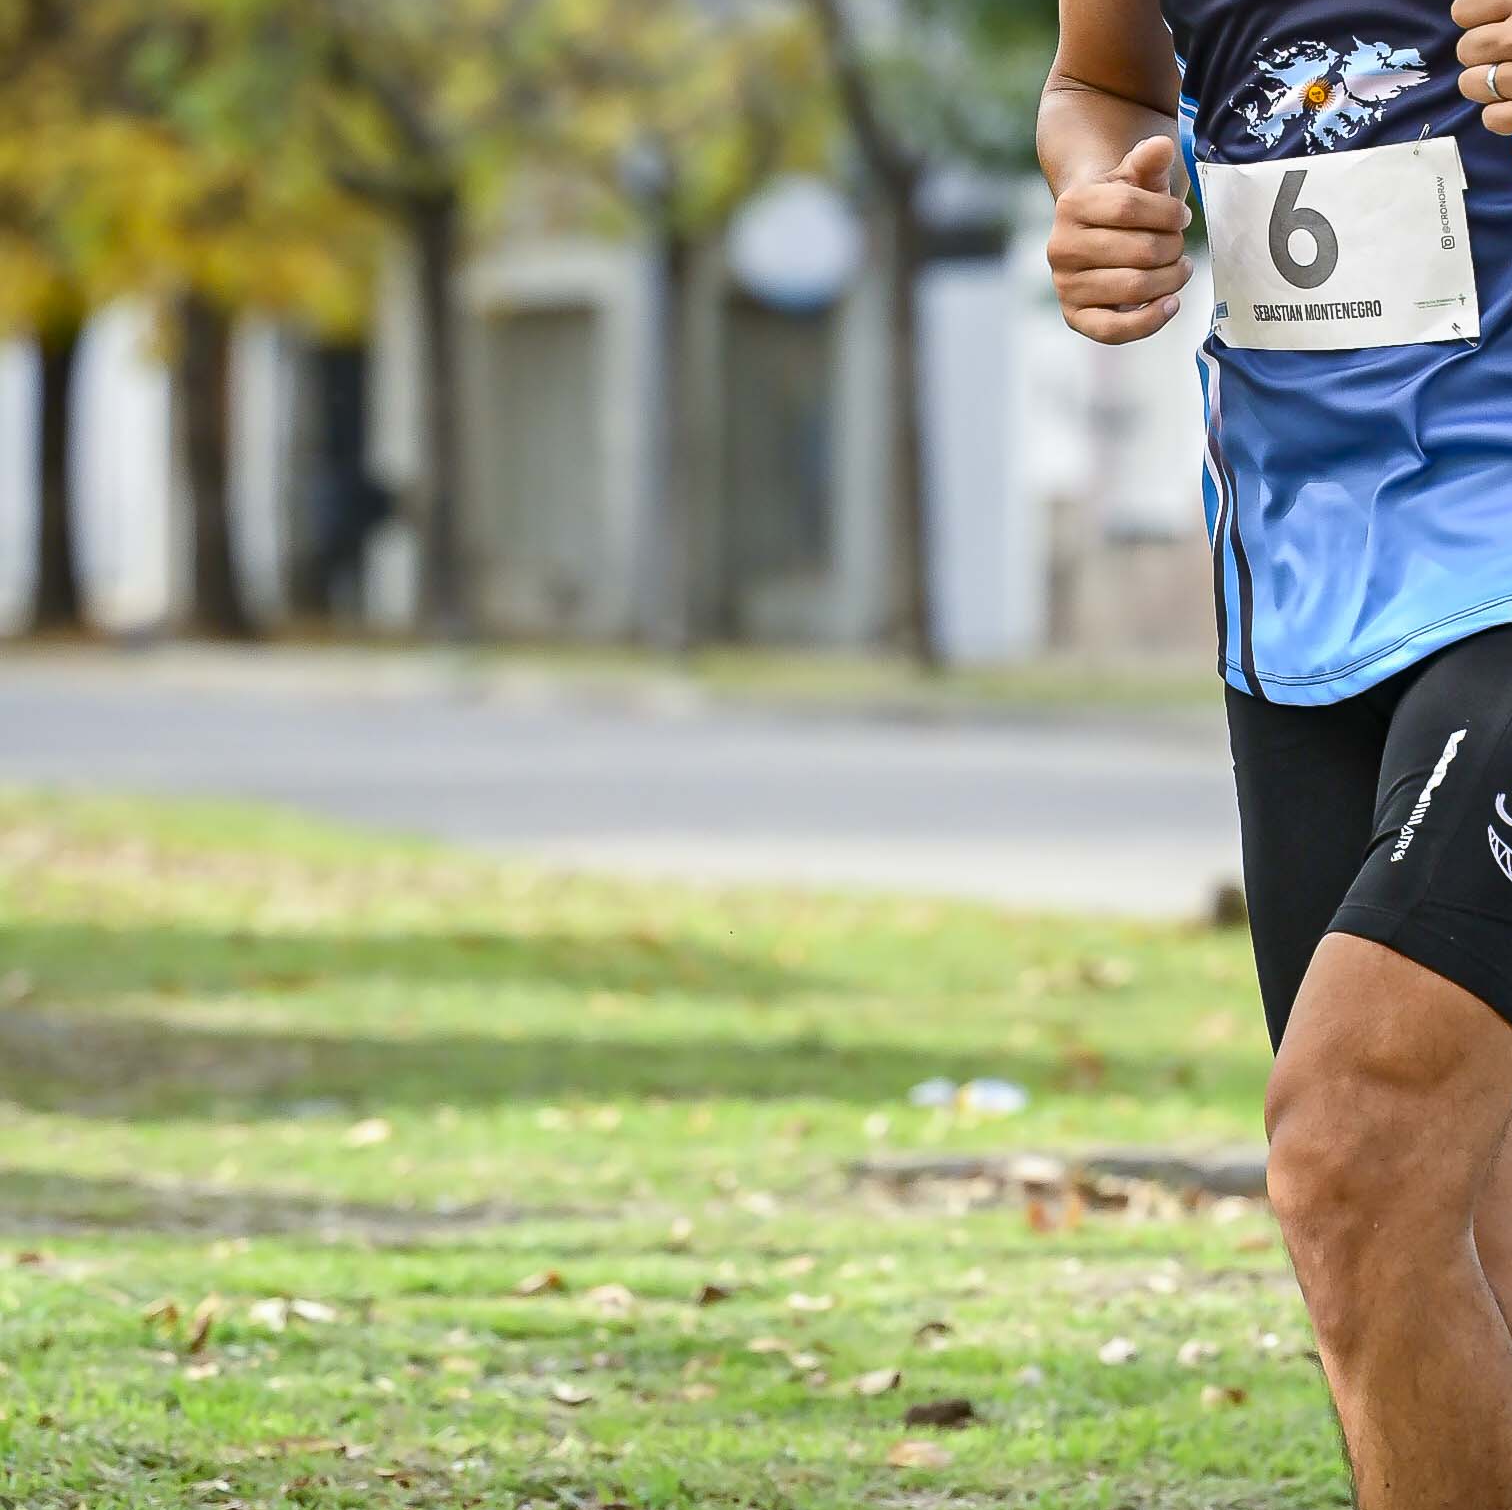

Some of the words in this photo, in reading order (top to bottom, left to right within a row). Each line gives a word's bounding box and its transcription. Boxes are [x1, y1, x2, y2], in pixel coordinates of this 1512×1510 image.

[1269, 170, 1338, 289] 6
[1253, 304, 1303, 322] SEBASTIAN
[1304, 299, 1382, 321] MONTENEGRO
